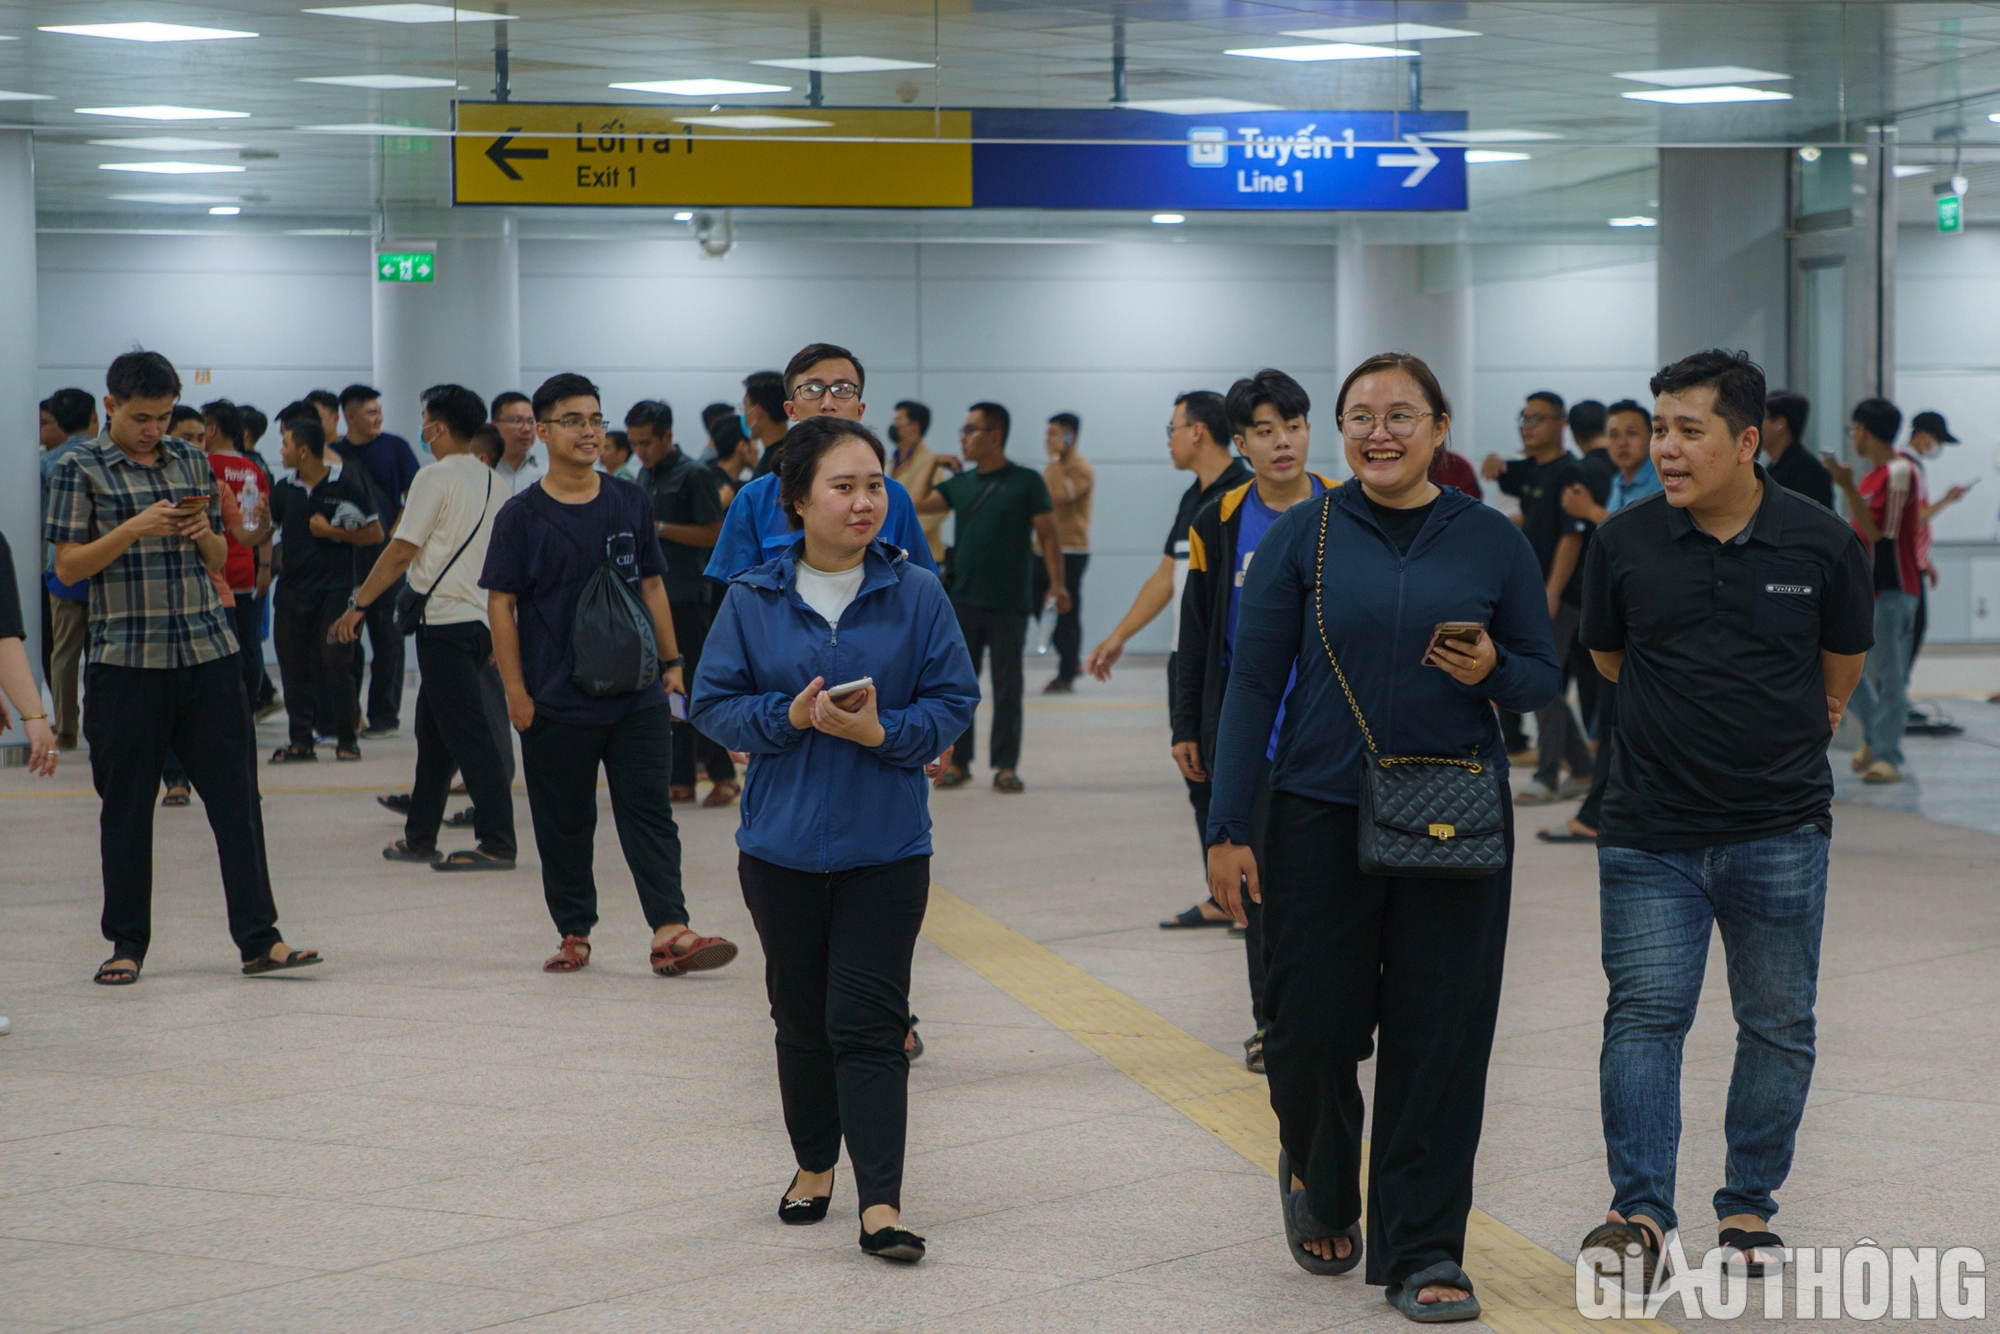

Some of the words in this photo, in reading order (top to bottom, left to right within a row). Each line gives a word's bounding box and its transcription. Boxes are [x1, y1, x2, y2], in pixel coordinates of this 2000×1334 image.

[576, 119, 625, 153] Lối
[638, 131, 670, 153] ra
[682, 124, 693, 154] 1
[1237, 123, 1332, 166] Tuyến
[1341, 128, 1355, 159] 1
[577, 165, 619, 188] Exit
[628, 166, 636, 188] 1
[1237, 169, 1288, 193] Line
[1293, 169, 1304, 193] 1
